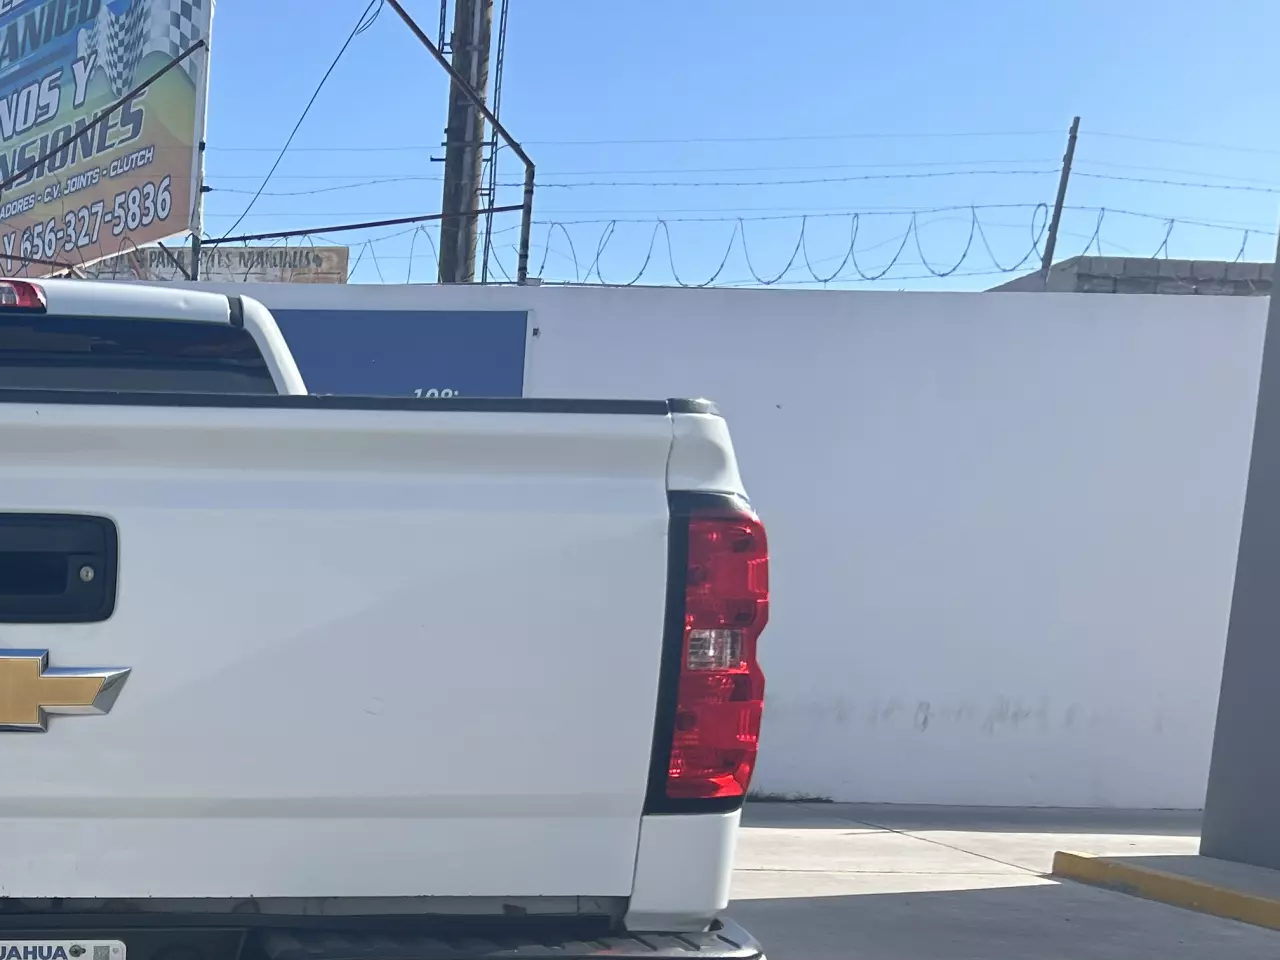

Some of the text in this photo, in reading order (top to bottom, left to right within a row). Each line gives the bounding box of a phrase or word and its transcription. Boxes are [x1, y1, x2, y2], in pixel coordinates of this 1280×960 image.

[72, 50, 98, 109] Y
[64, 167, 100, 195] JOINTS
[110, 145, 154, 177] CLUTCH
[3, 231, 16, 272] Y
[21, 175, 172, 265] 656-327-5836
